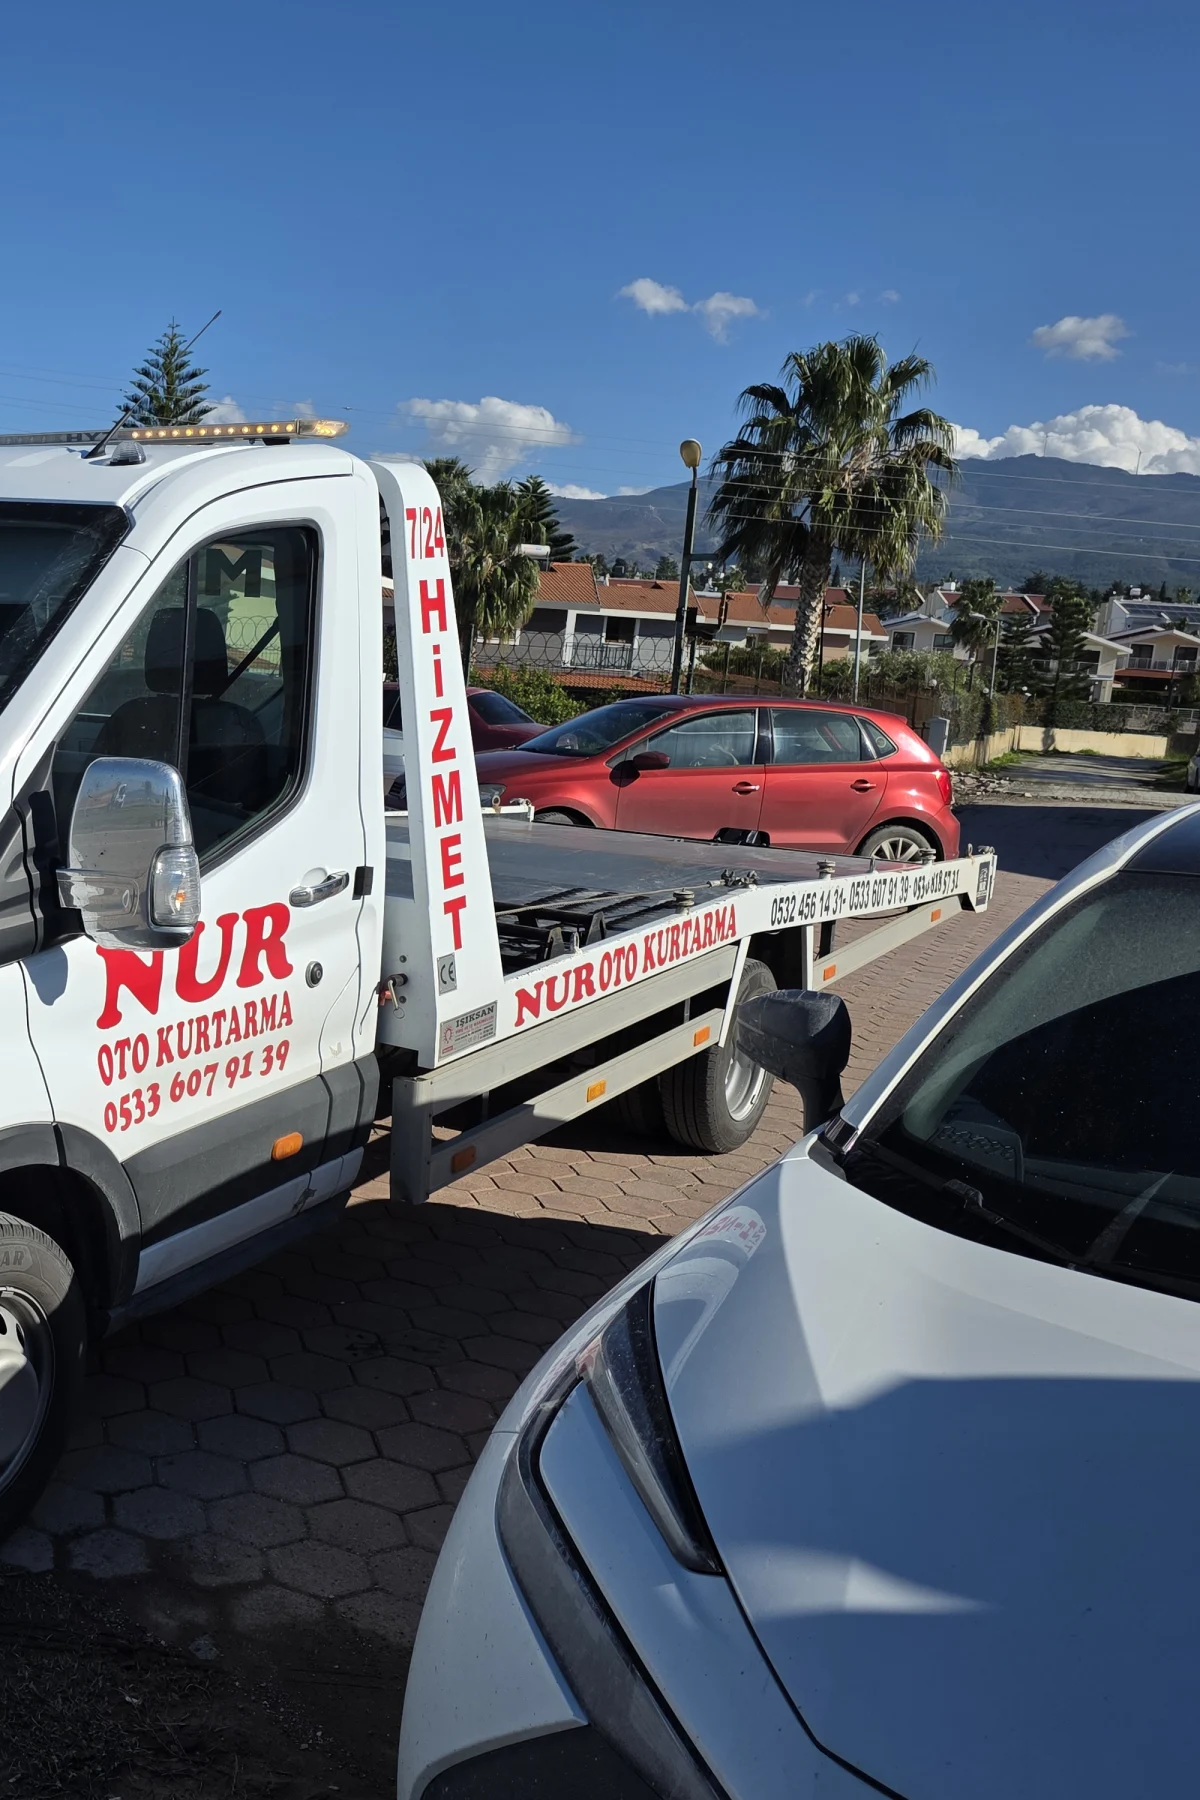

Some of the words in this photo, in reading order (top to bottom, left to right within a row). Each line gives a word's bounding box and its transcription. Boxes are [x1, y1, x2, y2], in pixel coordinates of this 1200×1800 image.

[770, 896, 795, 926] 0532
[798, 892, 817, 922] 456
[819, 889, 831, 918] 14
[849, 878, 870, 911] 0533
[872, 878, 887, 907] 607
[888, 876, 898, 906] 91
[95, 902, 294, 1030] NUR
[514, 962, 596, 1027] NUR
[598, 942, 638, 992] OTO
[642, 903, 737, 974] KURTARMA
[97, 1033, 150, 1087] OTO
[155, 990, 294, 1068] KURTARMA
[103, 1082, 161, 1133] 0533
[169, 1061, 219, 1103] 607
[225, 1050, 254, 1089] 91
[259, 1039, 290, 1076] 39
